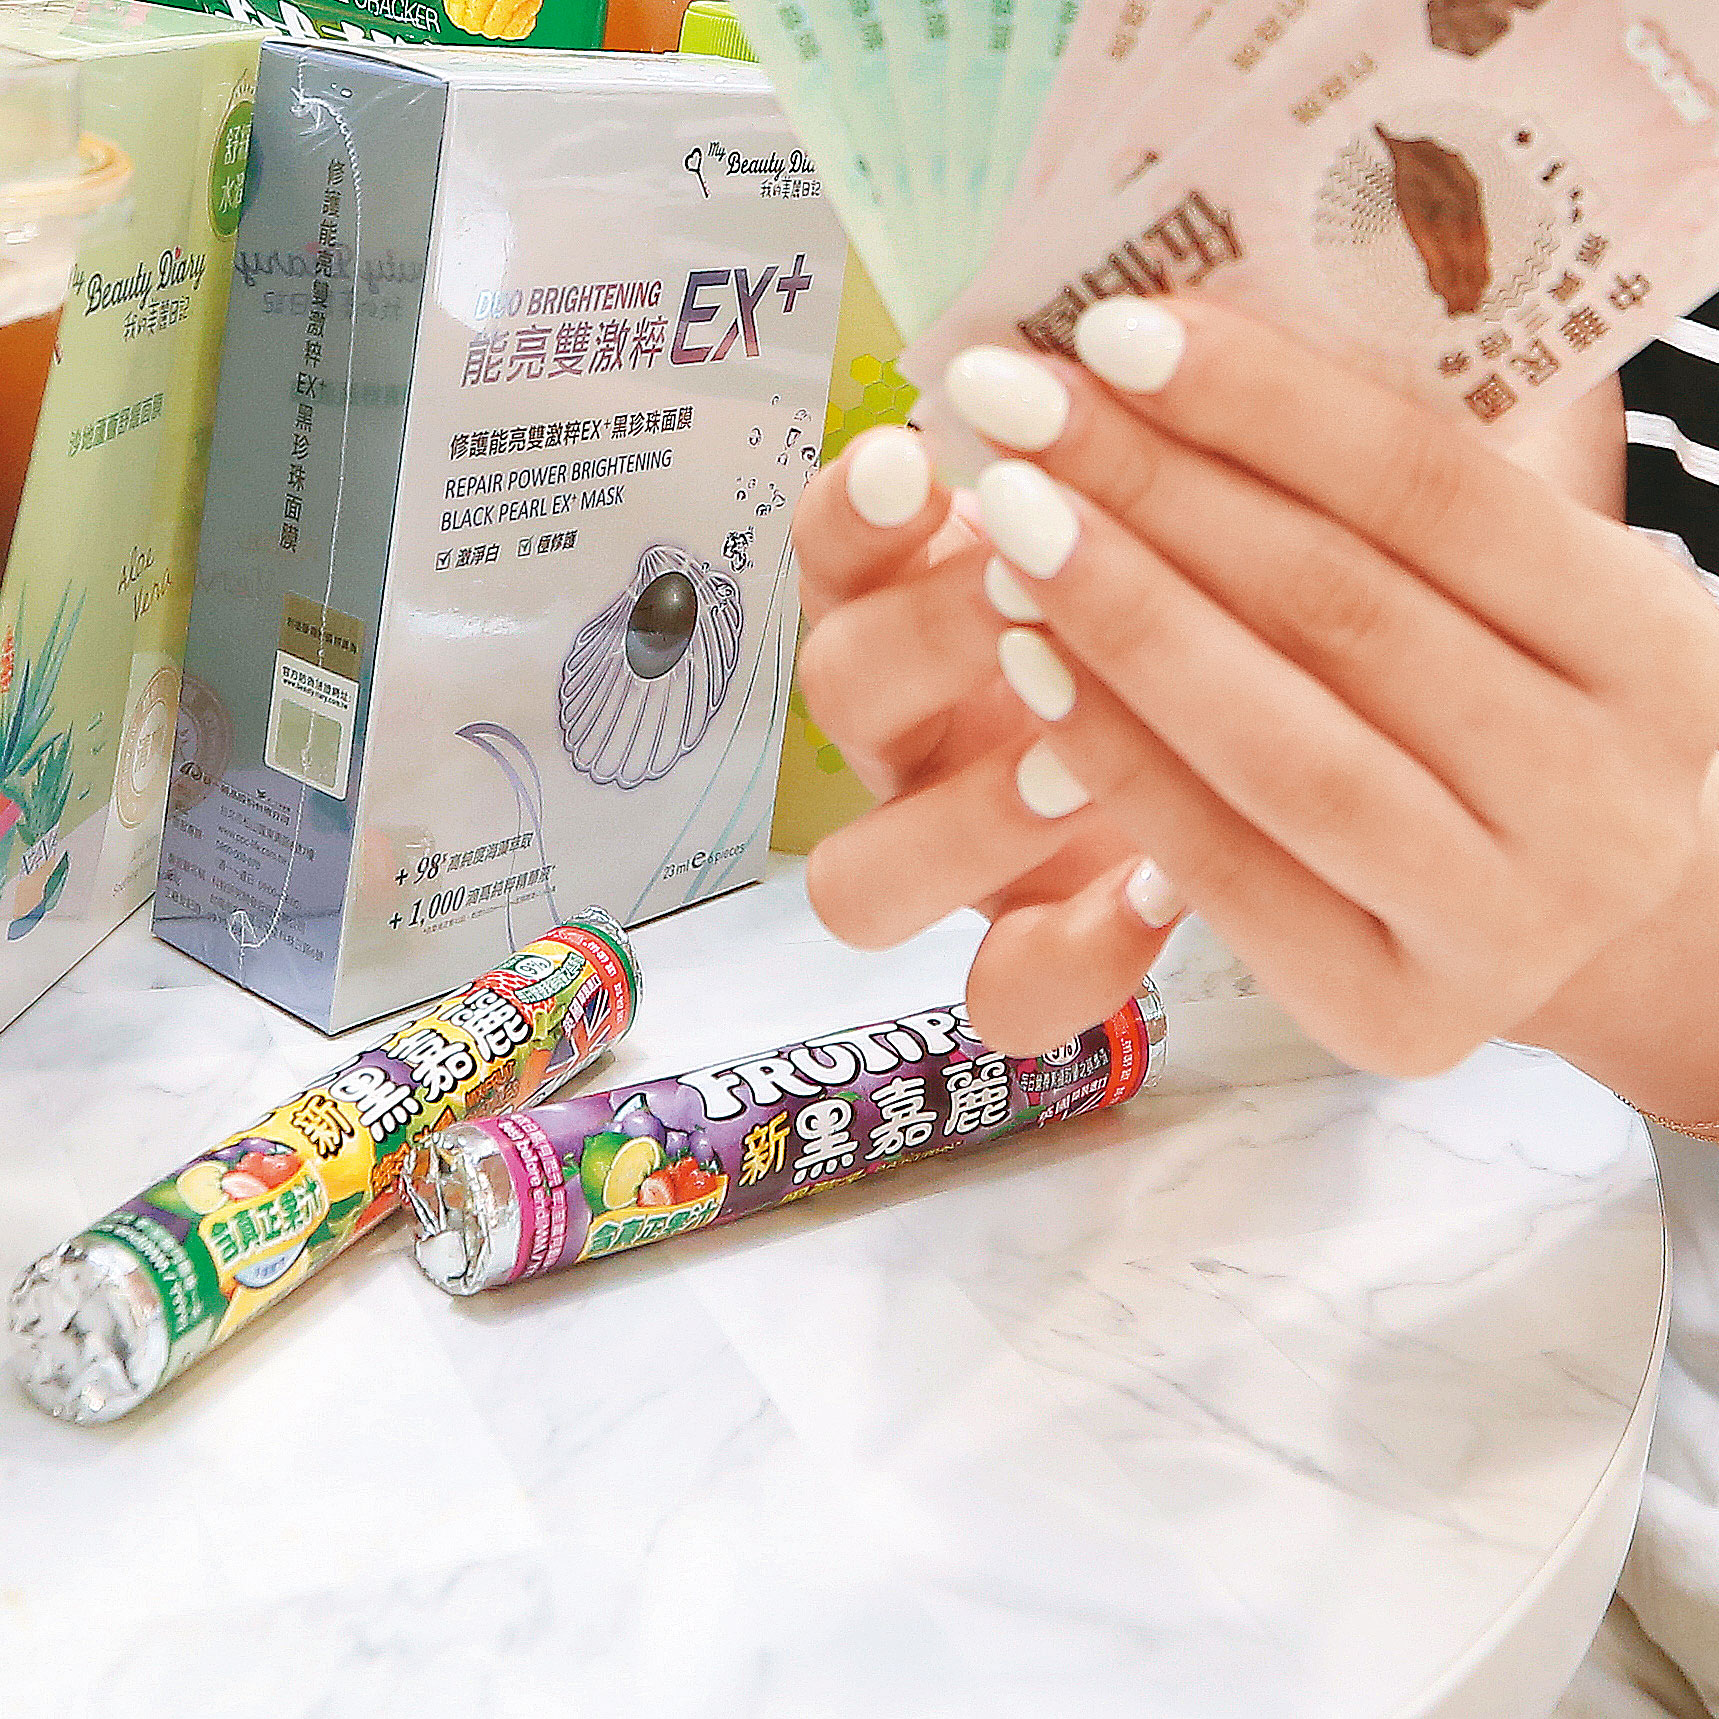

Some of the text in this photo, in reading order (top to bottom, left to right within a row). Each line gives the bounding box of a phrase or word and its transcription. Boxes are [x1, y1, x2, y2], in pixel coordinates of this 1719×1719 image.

[708, 142, 726, 162] My
[726, 151, 786, 182] Beauty
[84, 262, 153, 317] Beauty
[156, 249, 207, 290] Diary
[525, 280, 663, 318] BRIGHTENING
[460, 315, 670, 388] 能亮雙激粹
[1464, 272, 1653, 424] 中華民國
[444, 448, 673, 499] REPAIR POWER BRIGHTENING
[440, 504, 495, 532] BLACK
[497, 499, 548, 524] PEARL
[580, 484, 625, 510] MASK
[408, 885, 466, 928] 1,000
[292, 1094, 355, 1159] 新
[329, 987, 535, 1143] 黑嘉麗
[738, 1111, 791, 1187] 新
[792, 1049, 1011, 1185] 黑嘉麗
